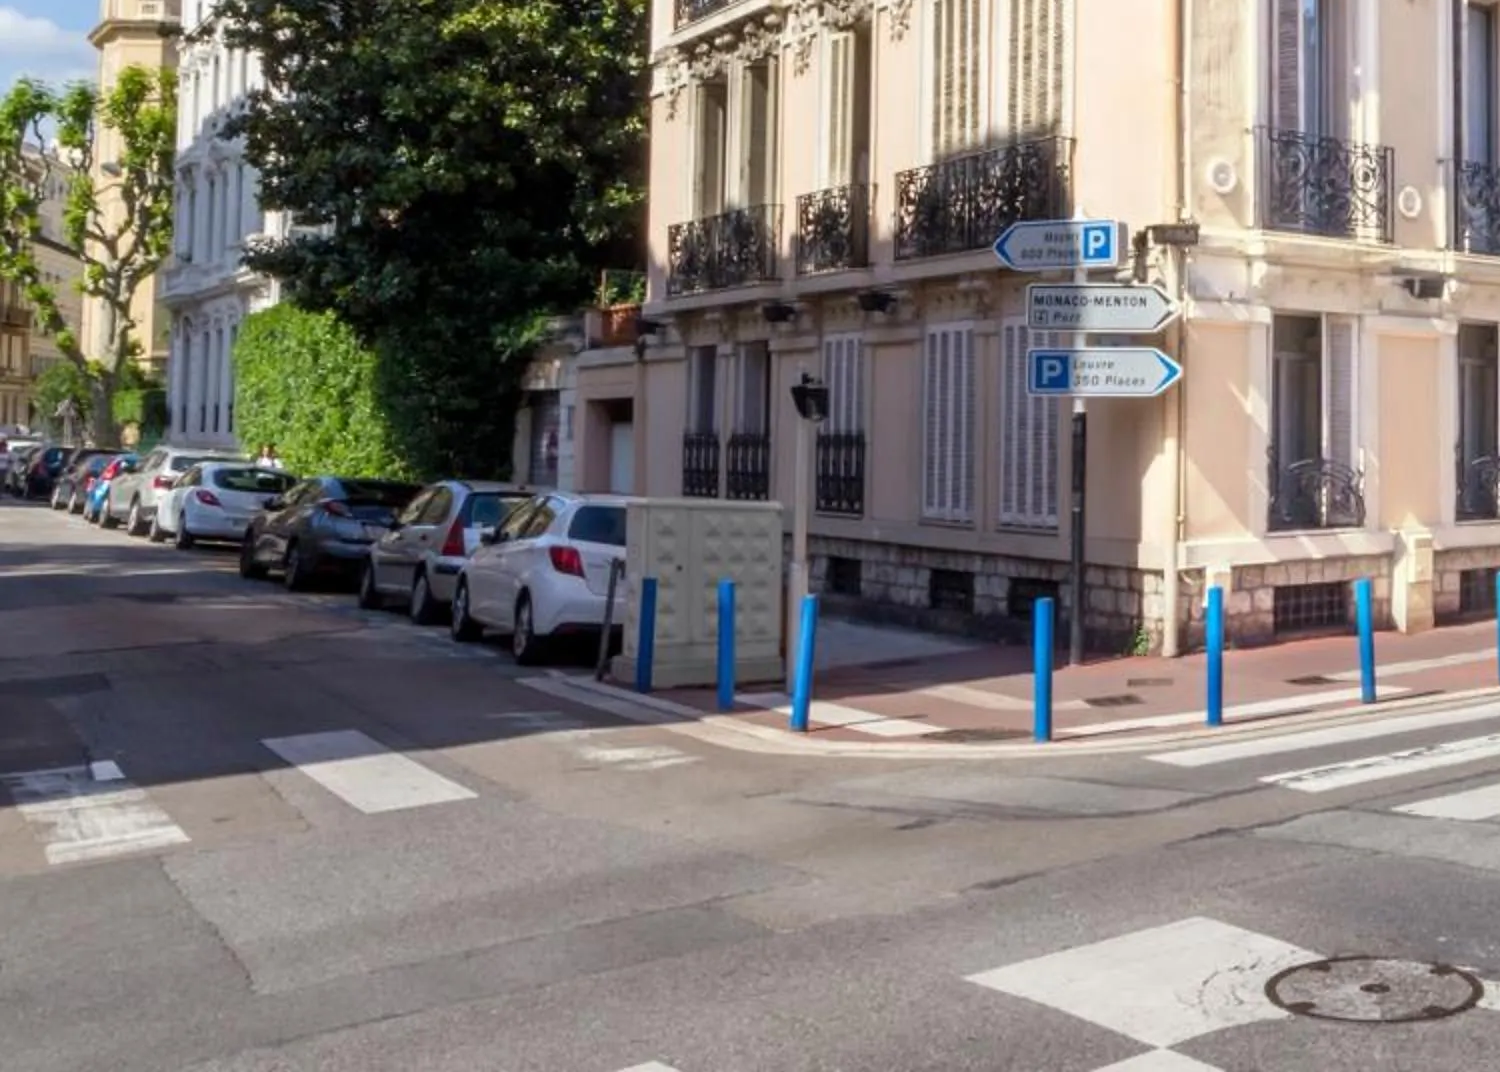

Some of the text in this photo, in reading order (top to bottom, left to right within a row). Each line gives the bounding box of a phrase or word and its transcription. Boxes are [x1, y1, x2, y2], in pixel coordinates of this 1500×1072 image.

[1087, 229, 1106, 256] P
[1041, 359, 1063, 385] P
[1105, 375, 1146, 386] Places
